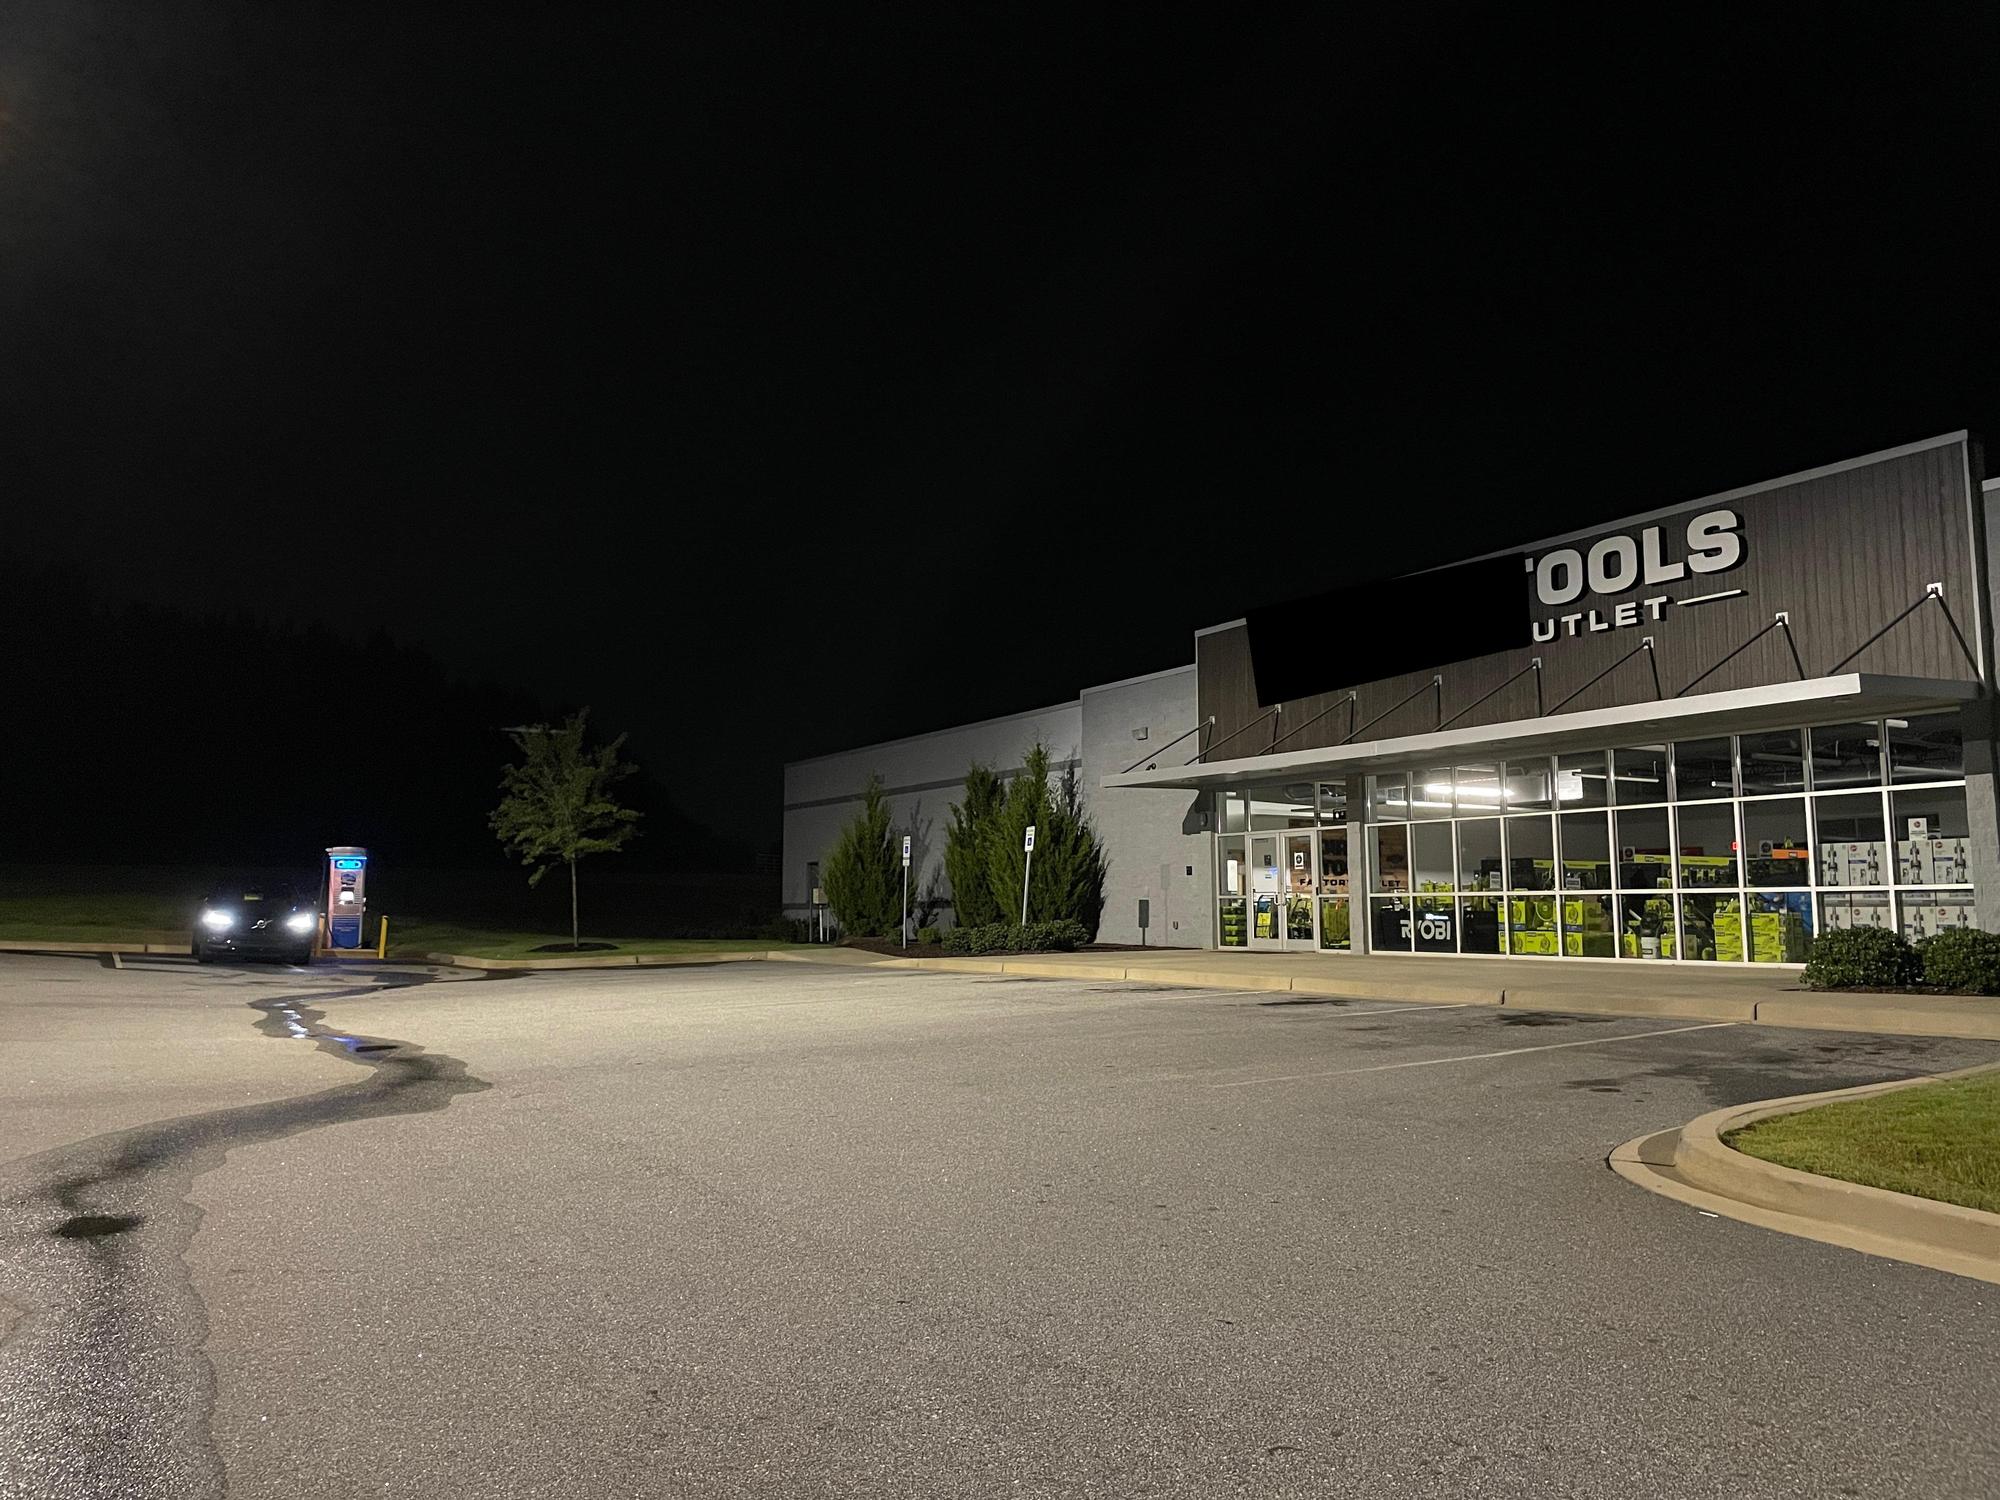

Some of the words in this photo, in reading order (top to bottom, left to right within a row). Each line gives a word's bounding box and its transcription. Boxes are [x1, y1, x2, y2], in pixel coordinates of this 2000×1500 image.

[1525, 509, 1740, 605] OOLS
[1532, 595, 1667, 642] UTLET
[1300, 878, 1349, 887] FATOR
